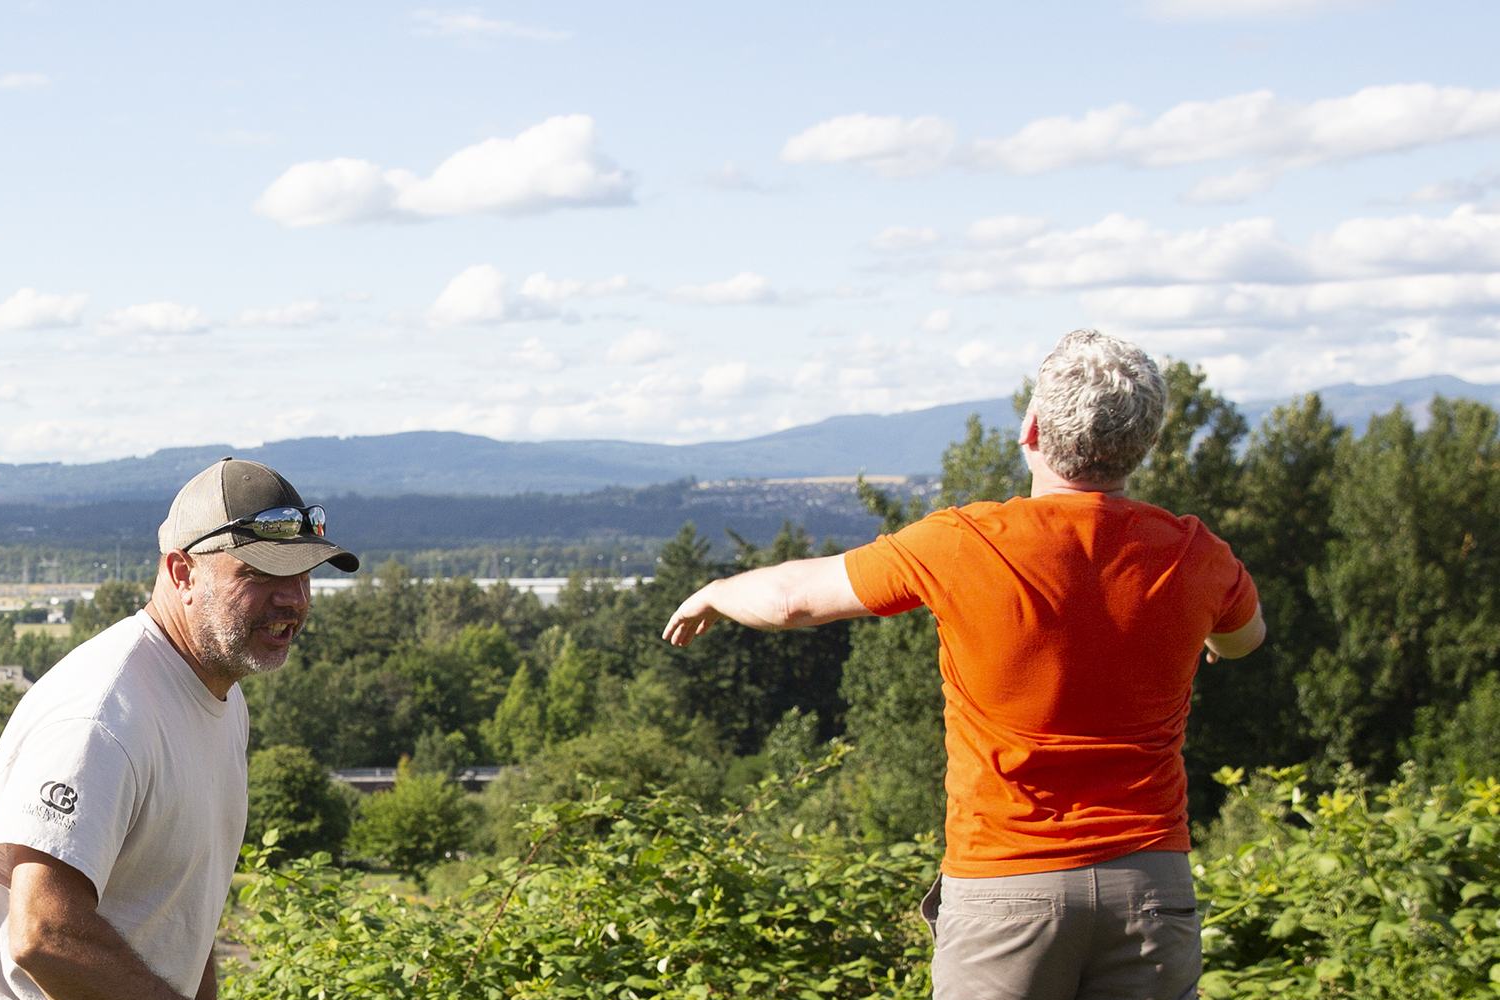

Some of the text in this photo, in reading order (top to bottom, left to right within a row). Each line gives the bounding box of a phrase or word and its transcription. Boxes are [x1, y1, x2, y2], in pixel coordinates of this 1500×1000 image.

[21, 808, 74, 831] COUNTY BANK
[23, 803, 77, 827] CLACKAMAS
